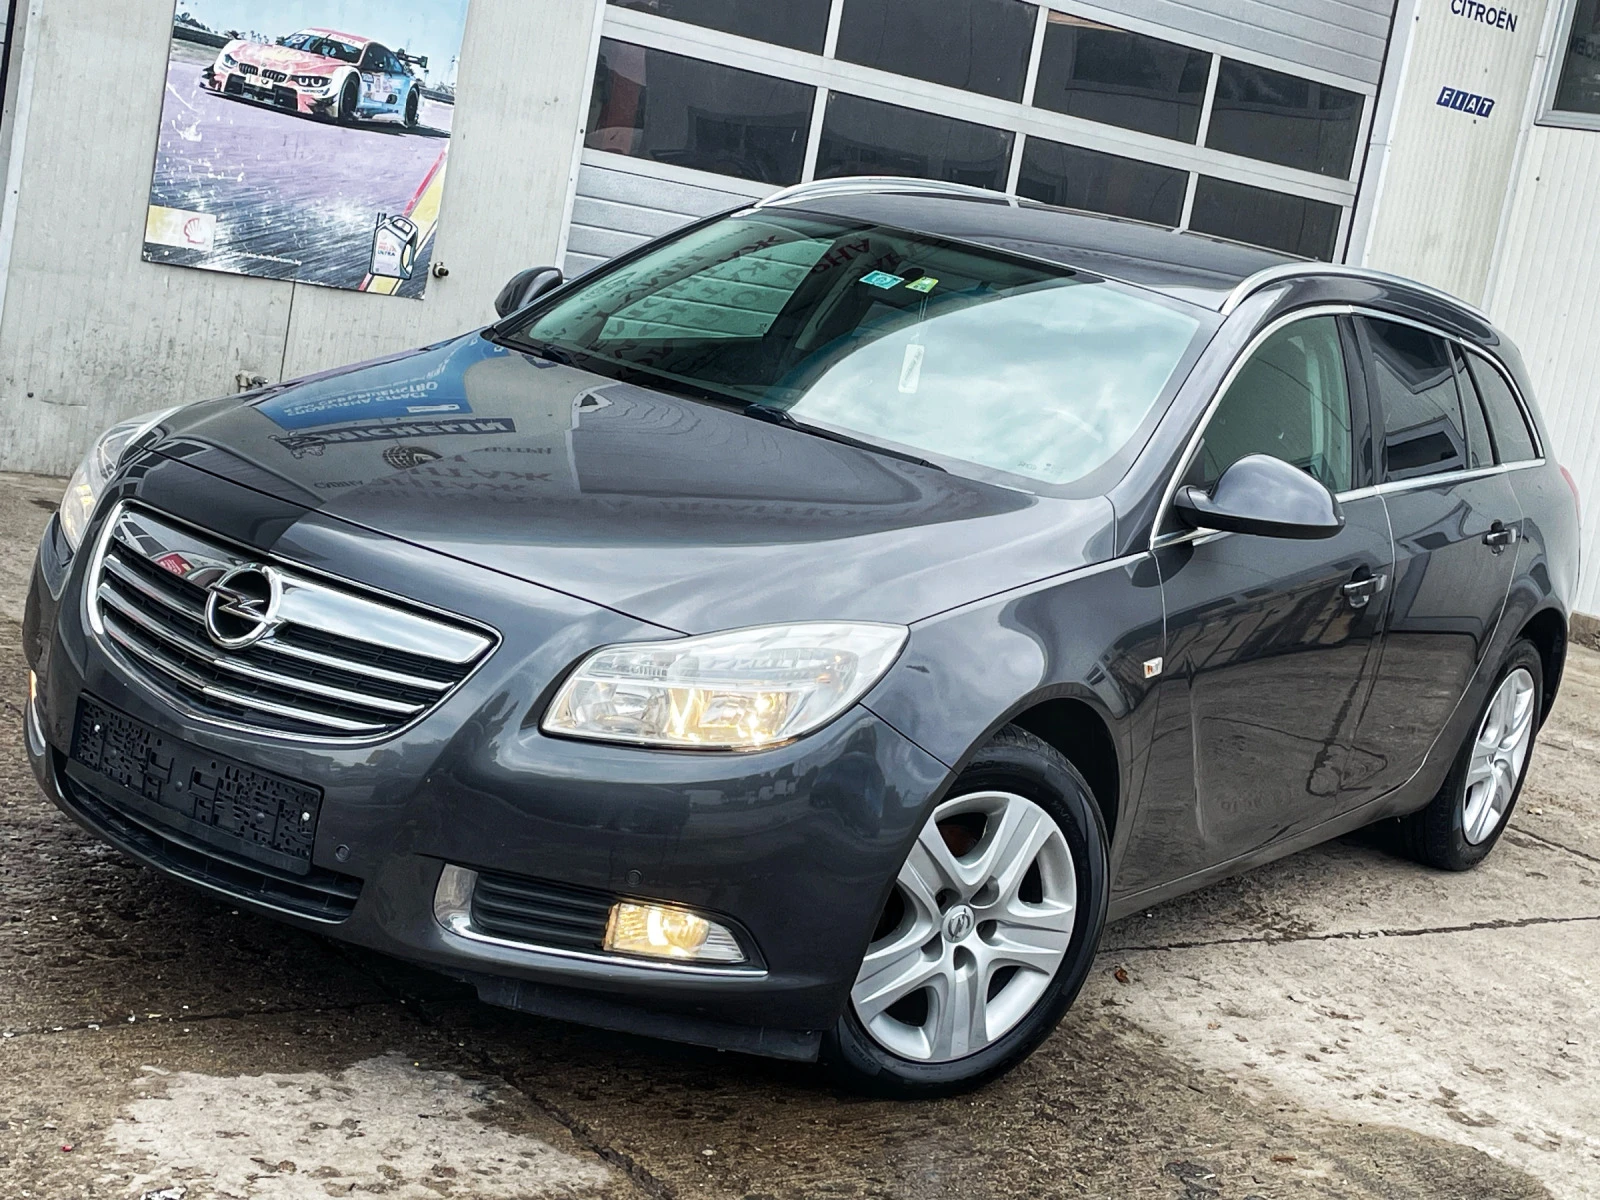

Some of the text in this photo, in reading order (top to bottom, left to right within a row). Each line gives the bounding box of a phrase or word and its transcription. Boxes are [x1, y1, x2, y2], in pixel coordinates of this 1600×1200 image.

[1451, 0, 1518, 32] CITROËN
[1437, 87, 1494, 117] FIAT
[377, 249, 396, 257] ULTRA
